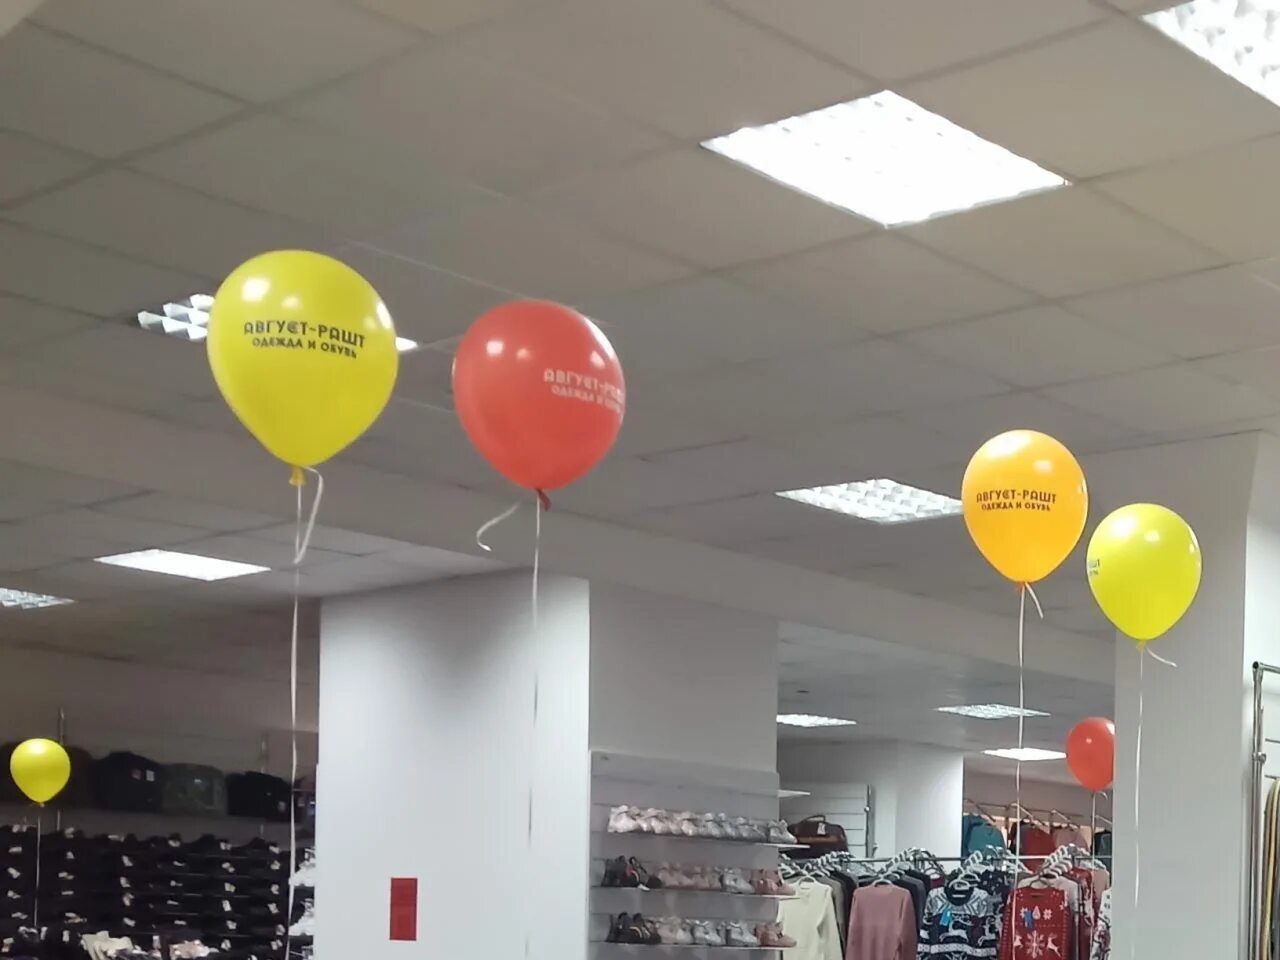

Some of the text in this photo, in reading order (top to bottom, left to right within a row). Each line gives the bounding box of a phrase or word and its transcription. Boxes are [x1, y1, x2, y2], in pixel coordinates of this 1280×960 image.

[244, 320, 364, 348] АВГУСТ-РАШТ
[252, 337, 357, 359] ОДЕЖДА И ОБУВЬ
[976, 489, 1056, 504] АВГУСТ-РАШТ
[981, 502, 1013, 511] ОДЕЖДА
[1025, 502, 1050, 511] ОБУВЬ
